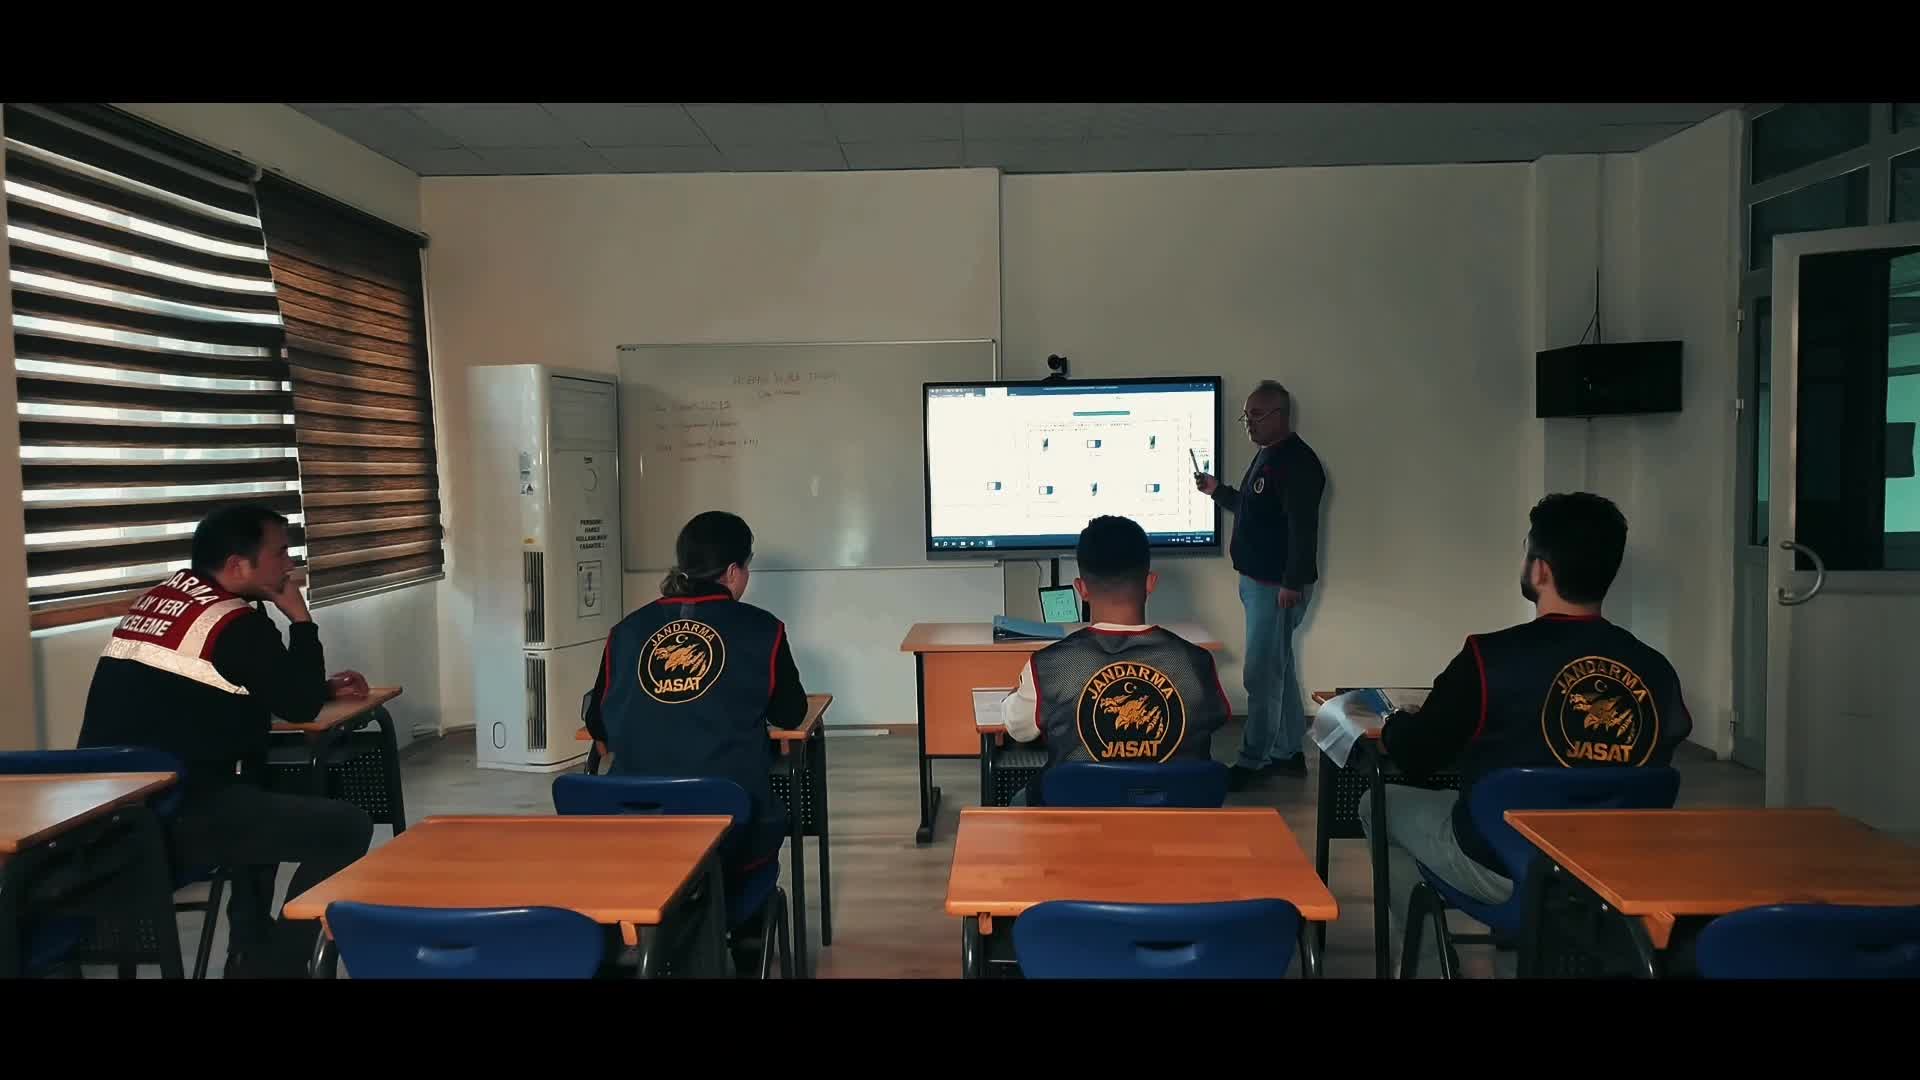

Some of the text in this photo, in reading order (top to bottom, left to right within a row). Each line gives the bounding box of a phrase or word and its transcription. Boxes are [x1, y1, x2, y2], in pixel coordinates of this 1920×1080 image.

[153, 598, 194, 617] YERİ
[120, 614, 173, 637] CELEME
[651, 622, 716, 647] JANDARMA
[654, 677, 702, 694] JASAT
[1088, 665, 1174, 700] JANDARMA
[1557, 660, 1648, 703] JANDARMA
[1101, 740, 1161, 758] JASAT
[1566, 741, 1633, 762] JASAT
